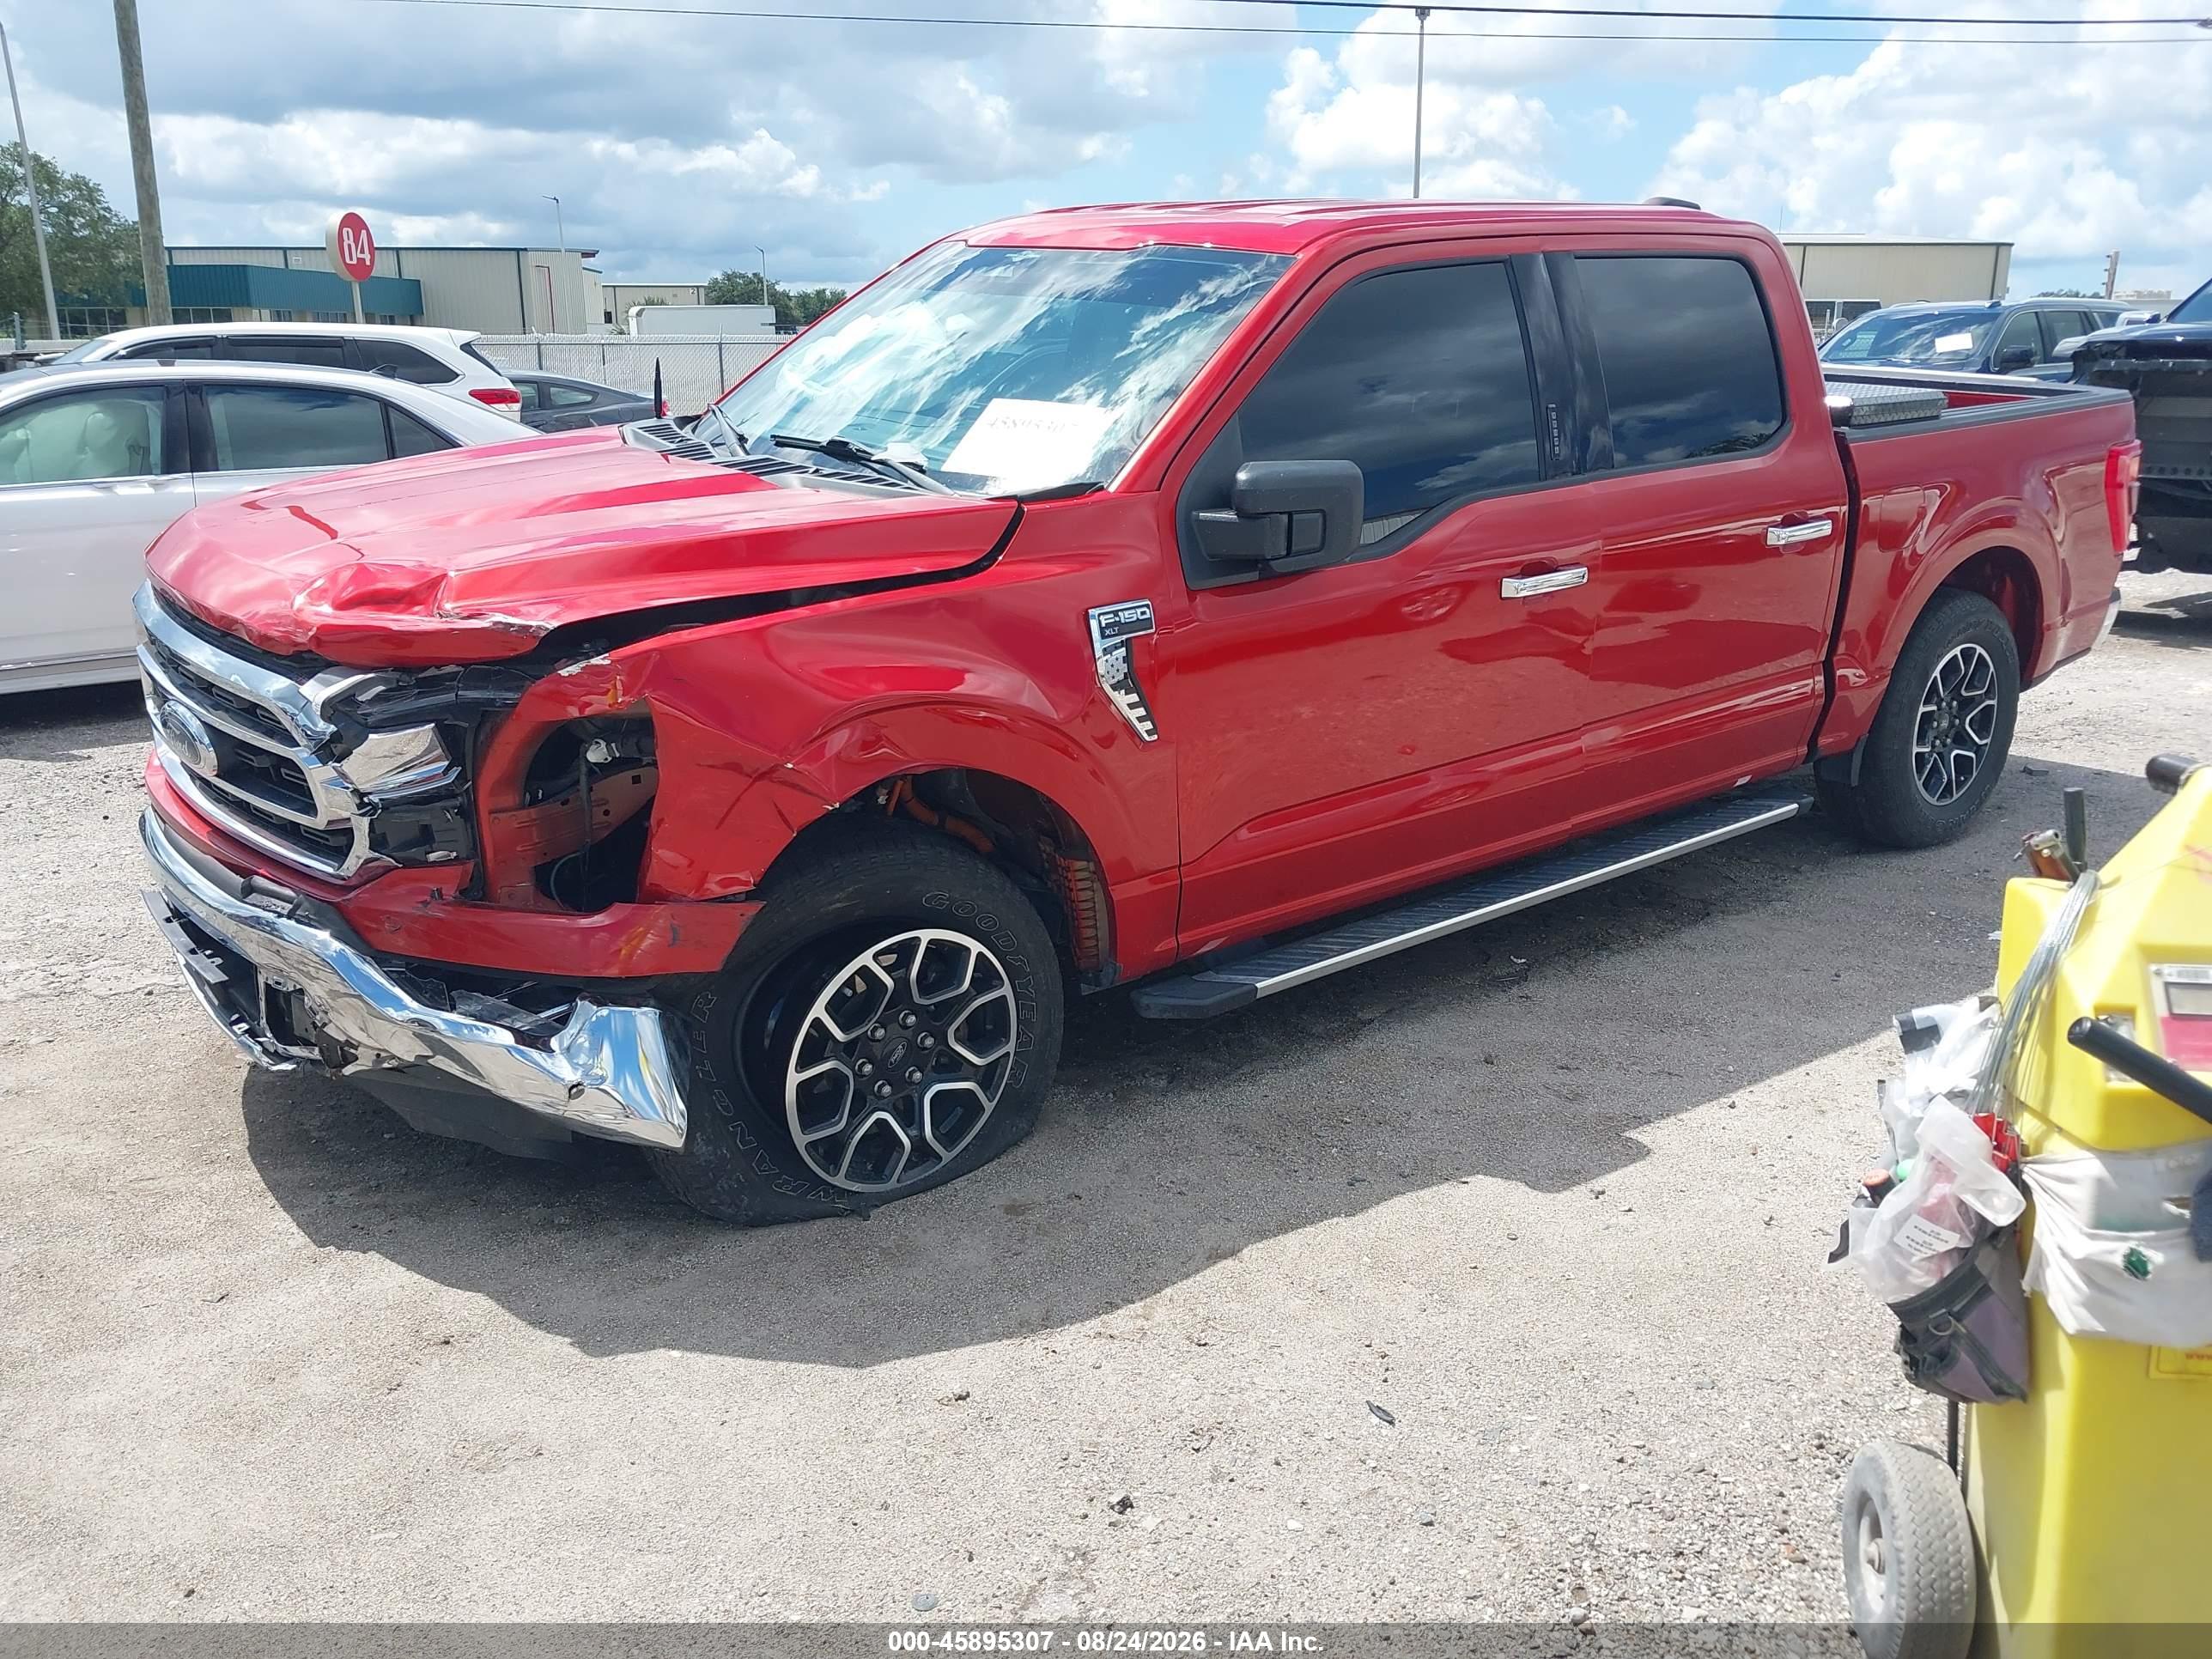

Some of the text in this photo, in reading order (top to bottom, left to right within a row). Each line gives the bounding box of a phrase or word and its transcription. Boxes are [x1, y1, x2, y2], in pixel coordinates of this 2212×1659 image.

[343, 227, 371, 265] 84
[1099, 606, 1152, 628] F-150
[1104, 626, 1120, 636] XLT
[166, 721, 193, 758] Ford
[921, 890, 1037, 1089] GOODYEAR
